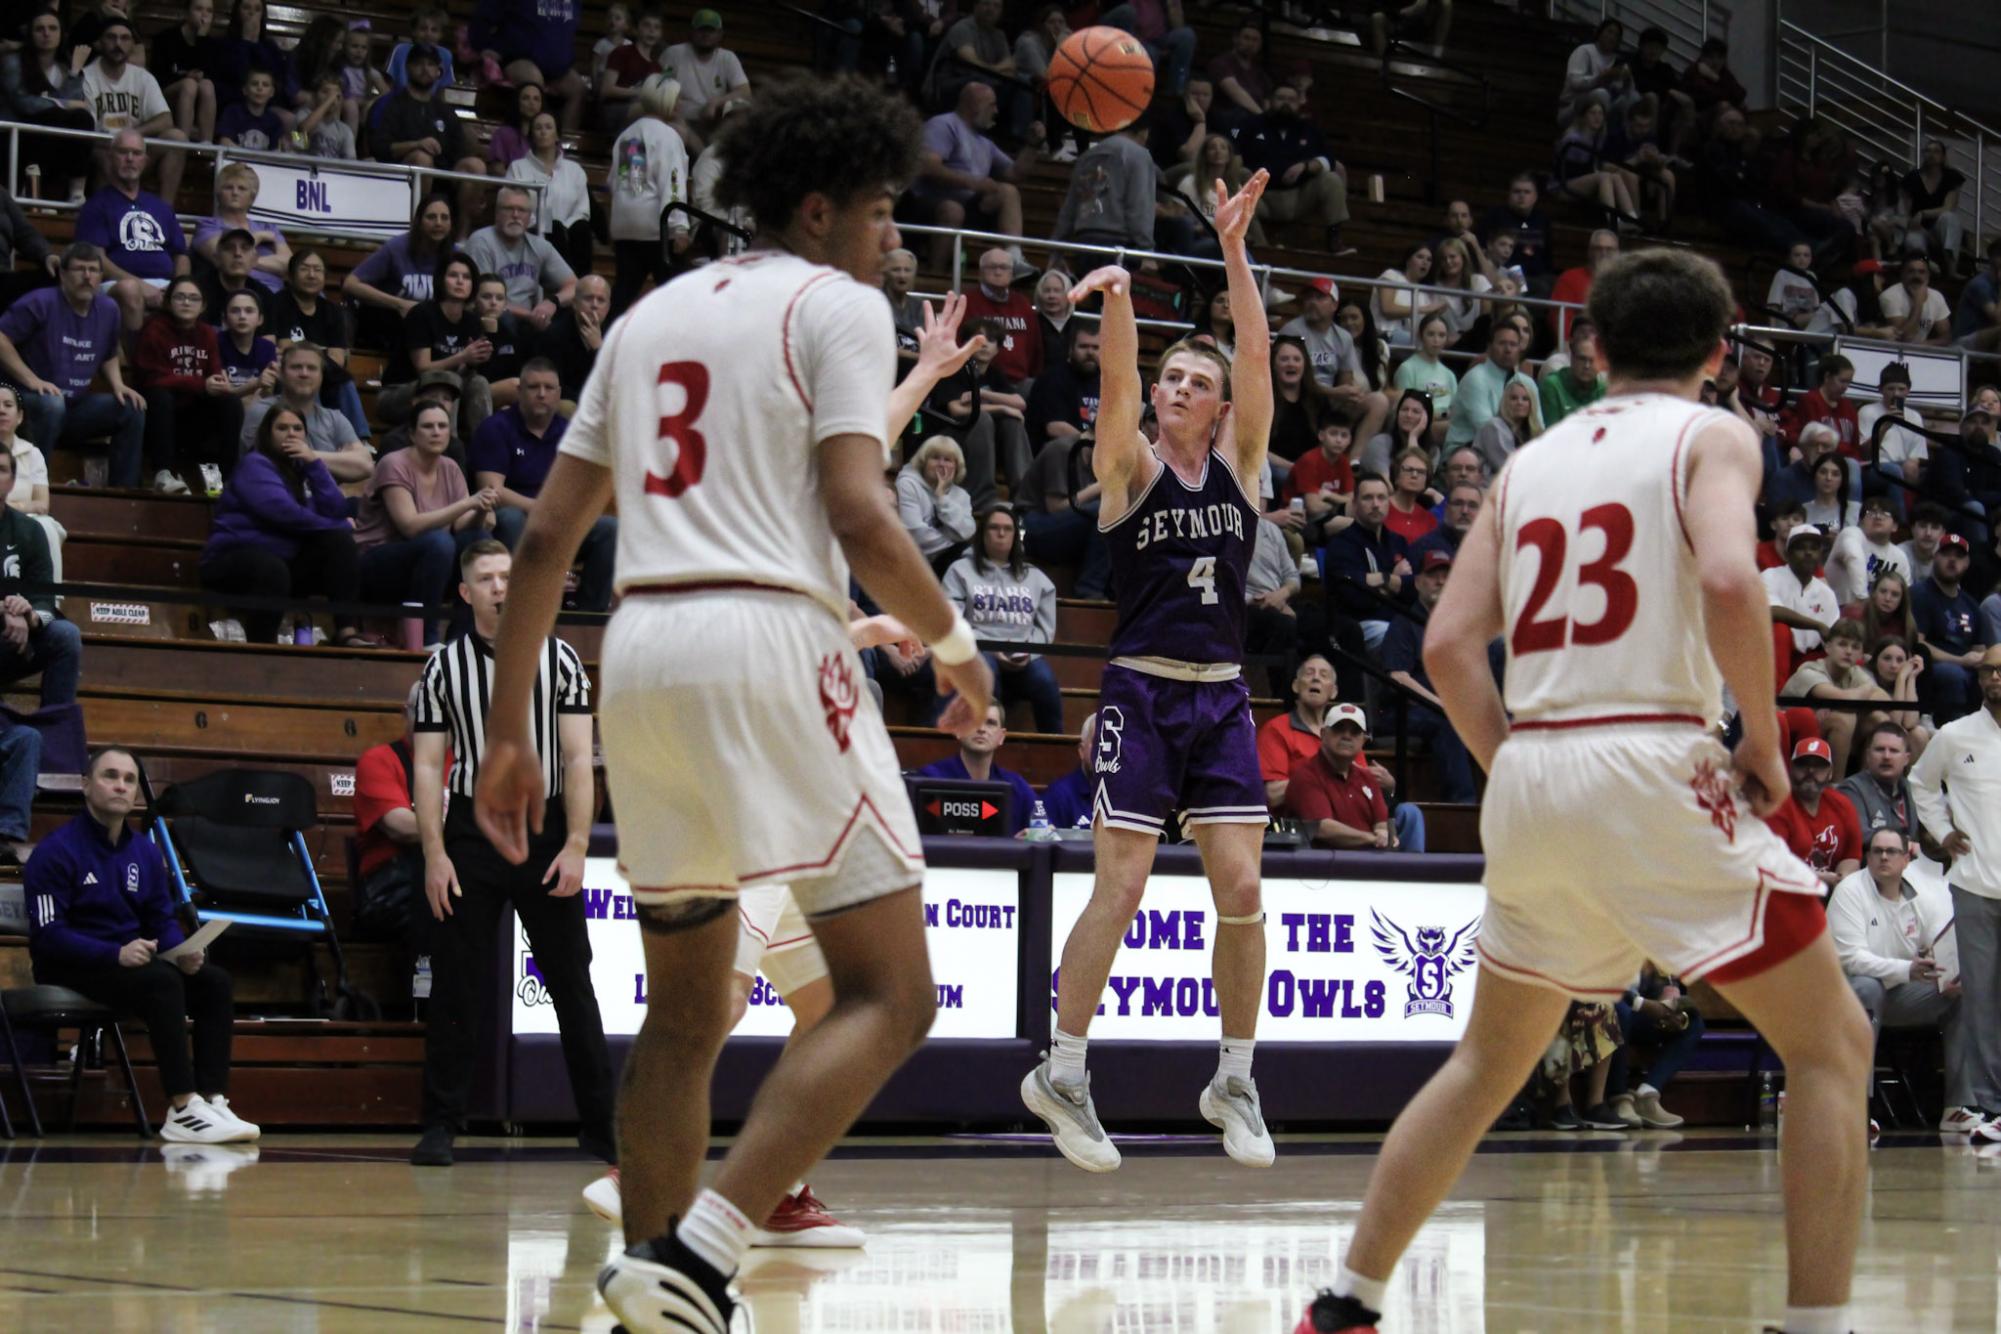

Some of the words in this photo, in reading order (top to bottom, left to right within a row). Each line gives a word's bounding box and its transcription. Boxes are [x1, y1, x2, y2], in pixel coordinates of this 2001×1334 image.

[296, 179, 332, 213] BNL
[644, 359, 710, 498] 3
[1136, 503, 1244, 551] SEYMOUR
[1187, 556, 1219, 605] 4
[1512, 502, 1638, 658] 23
[974, 594, 1034, 613] STARS
[1095, 755, 1122, 773] Owls
[336, 780, 352, 788] KEEP
[943, 802, 980, 817] POSS
[946, 899, 1016, 929] COURT
[1123, 909, 1205, 950] OME
[1281, 913, 1354, 953] THE
[1268, 969, 1386, 1018] OWLS
[1422, 962, 1439, 998] S
